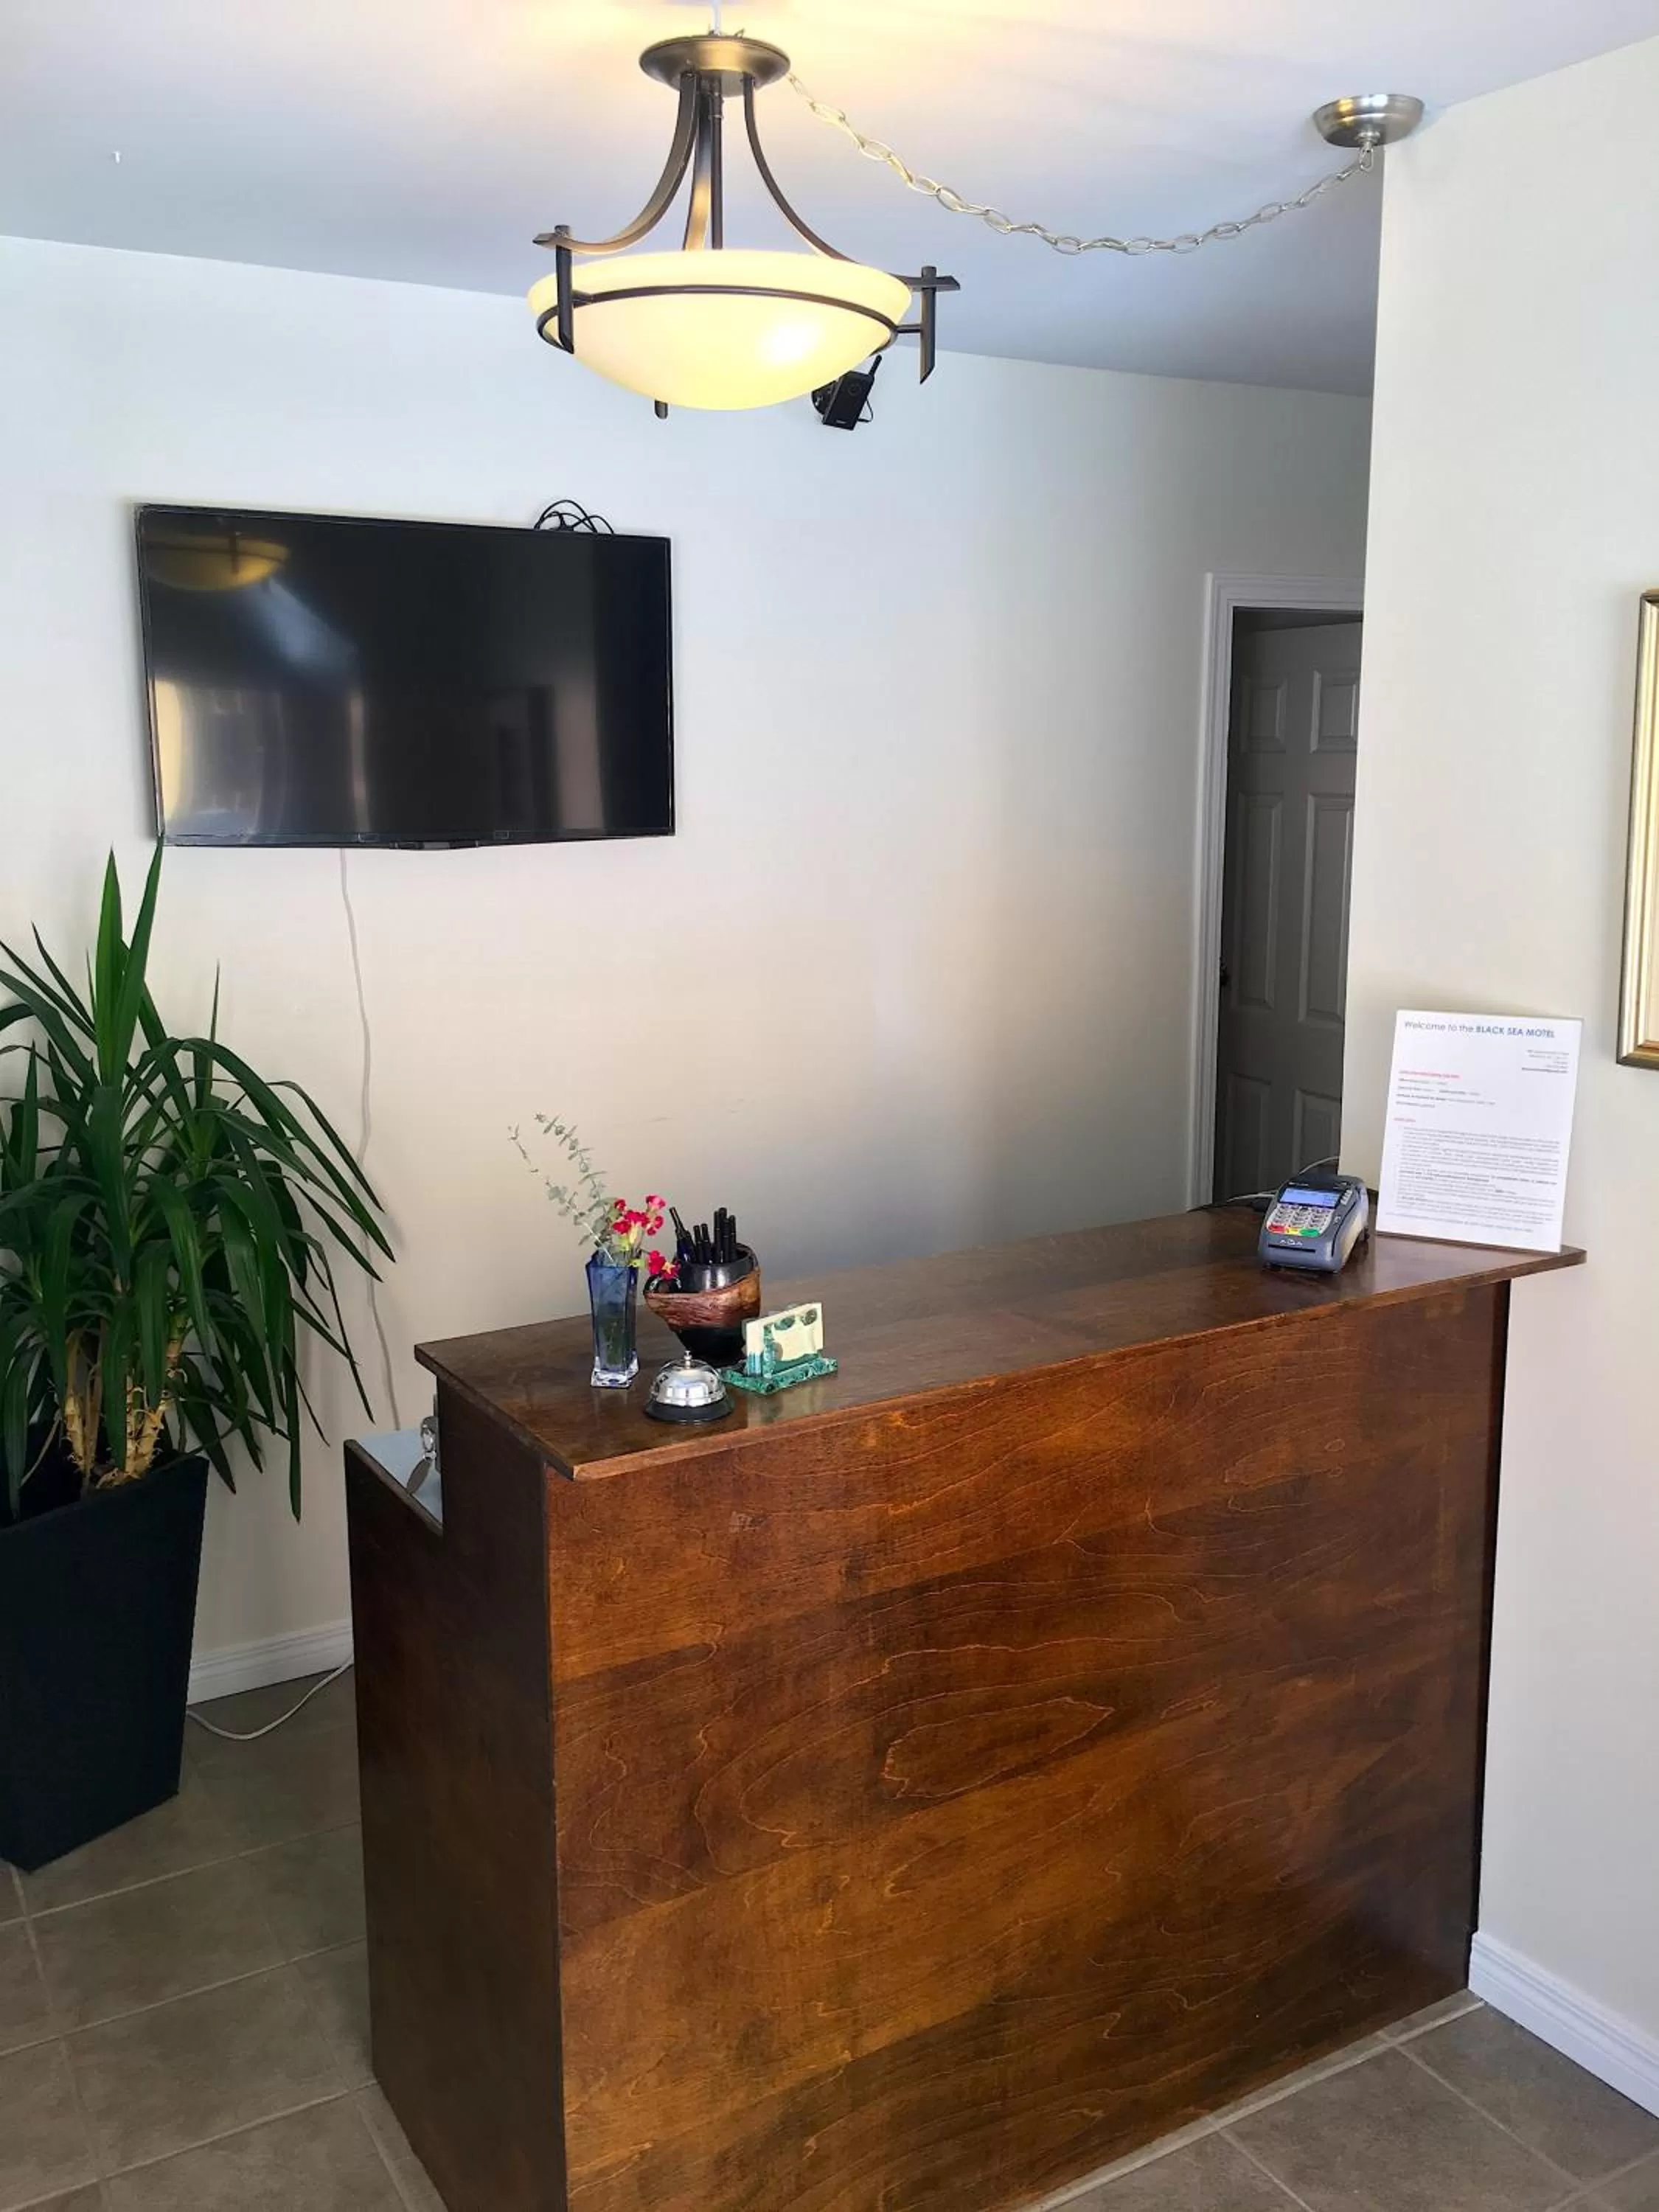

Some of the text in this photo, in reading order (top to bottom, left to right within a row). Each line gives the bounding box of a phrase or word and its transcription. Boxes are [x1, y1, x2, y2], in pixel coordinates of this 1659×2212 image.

[1405, 1020, 1446, 1032] Welcome
[1459, 1023, 1474, 1033] the
[1475, 1026, 1505, 1035] BLACK
[1507, 1027, 1524, 1036] SEA
[1526, 1028, 1555, 1038] MOTEL
